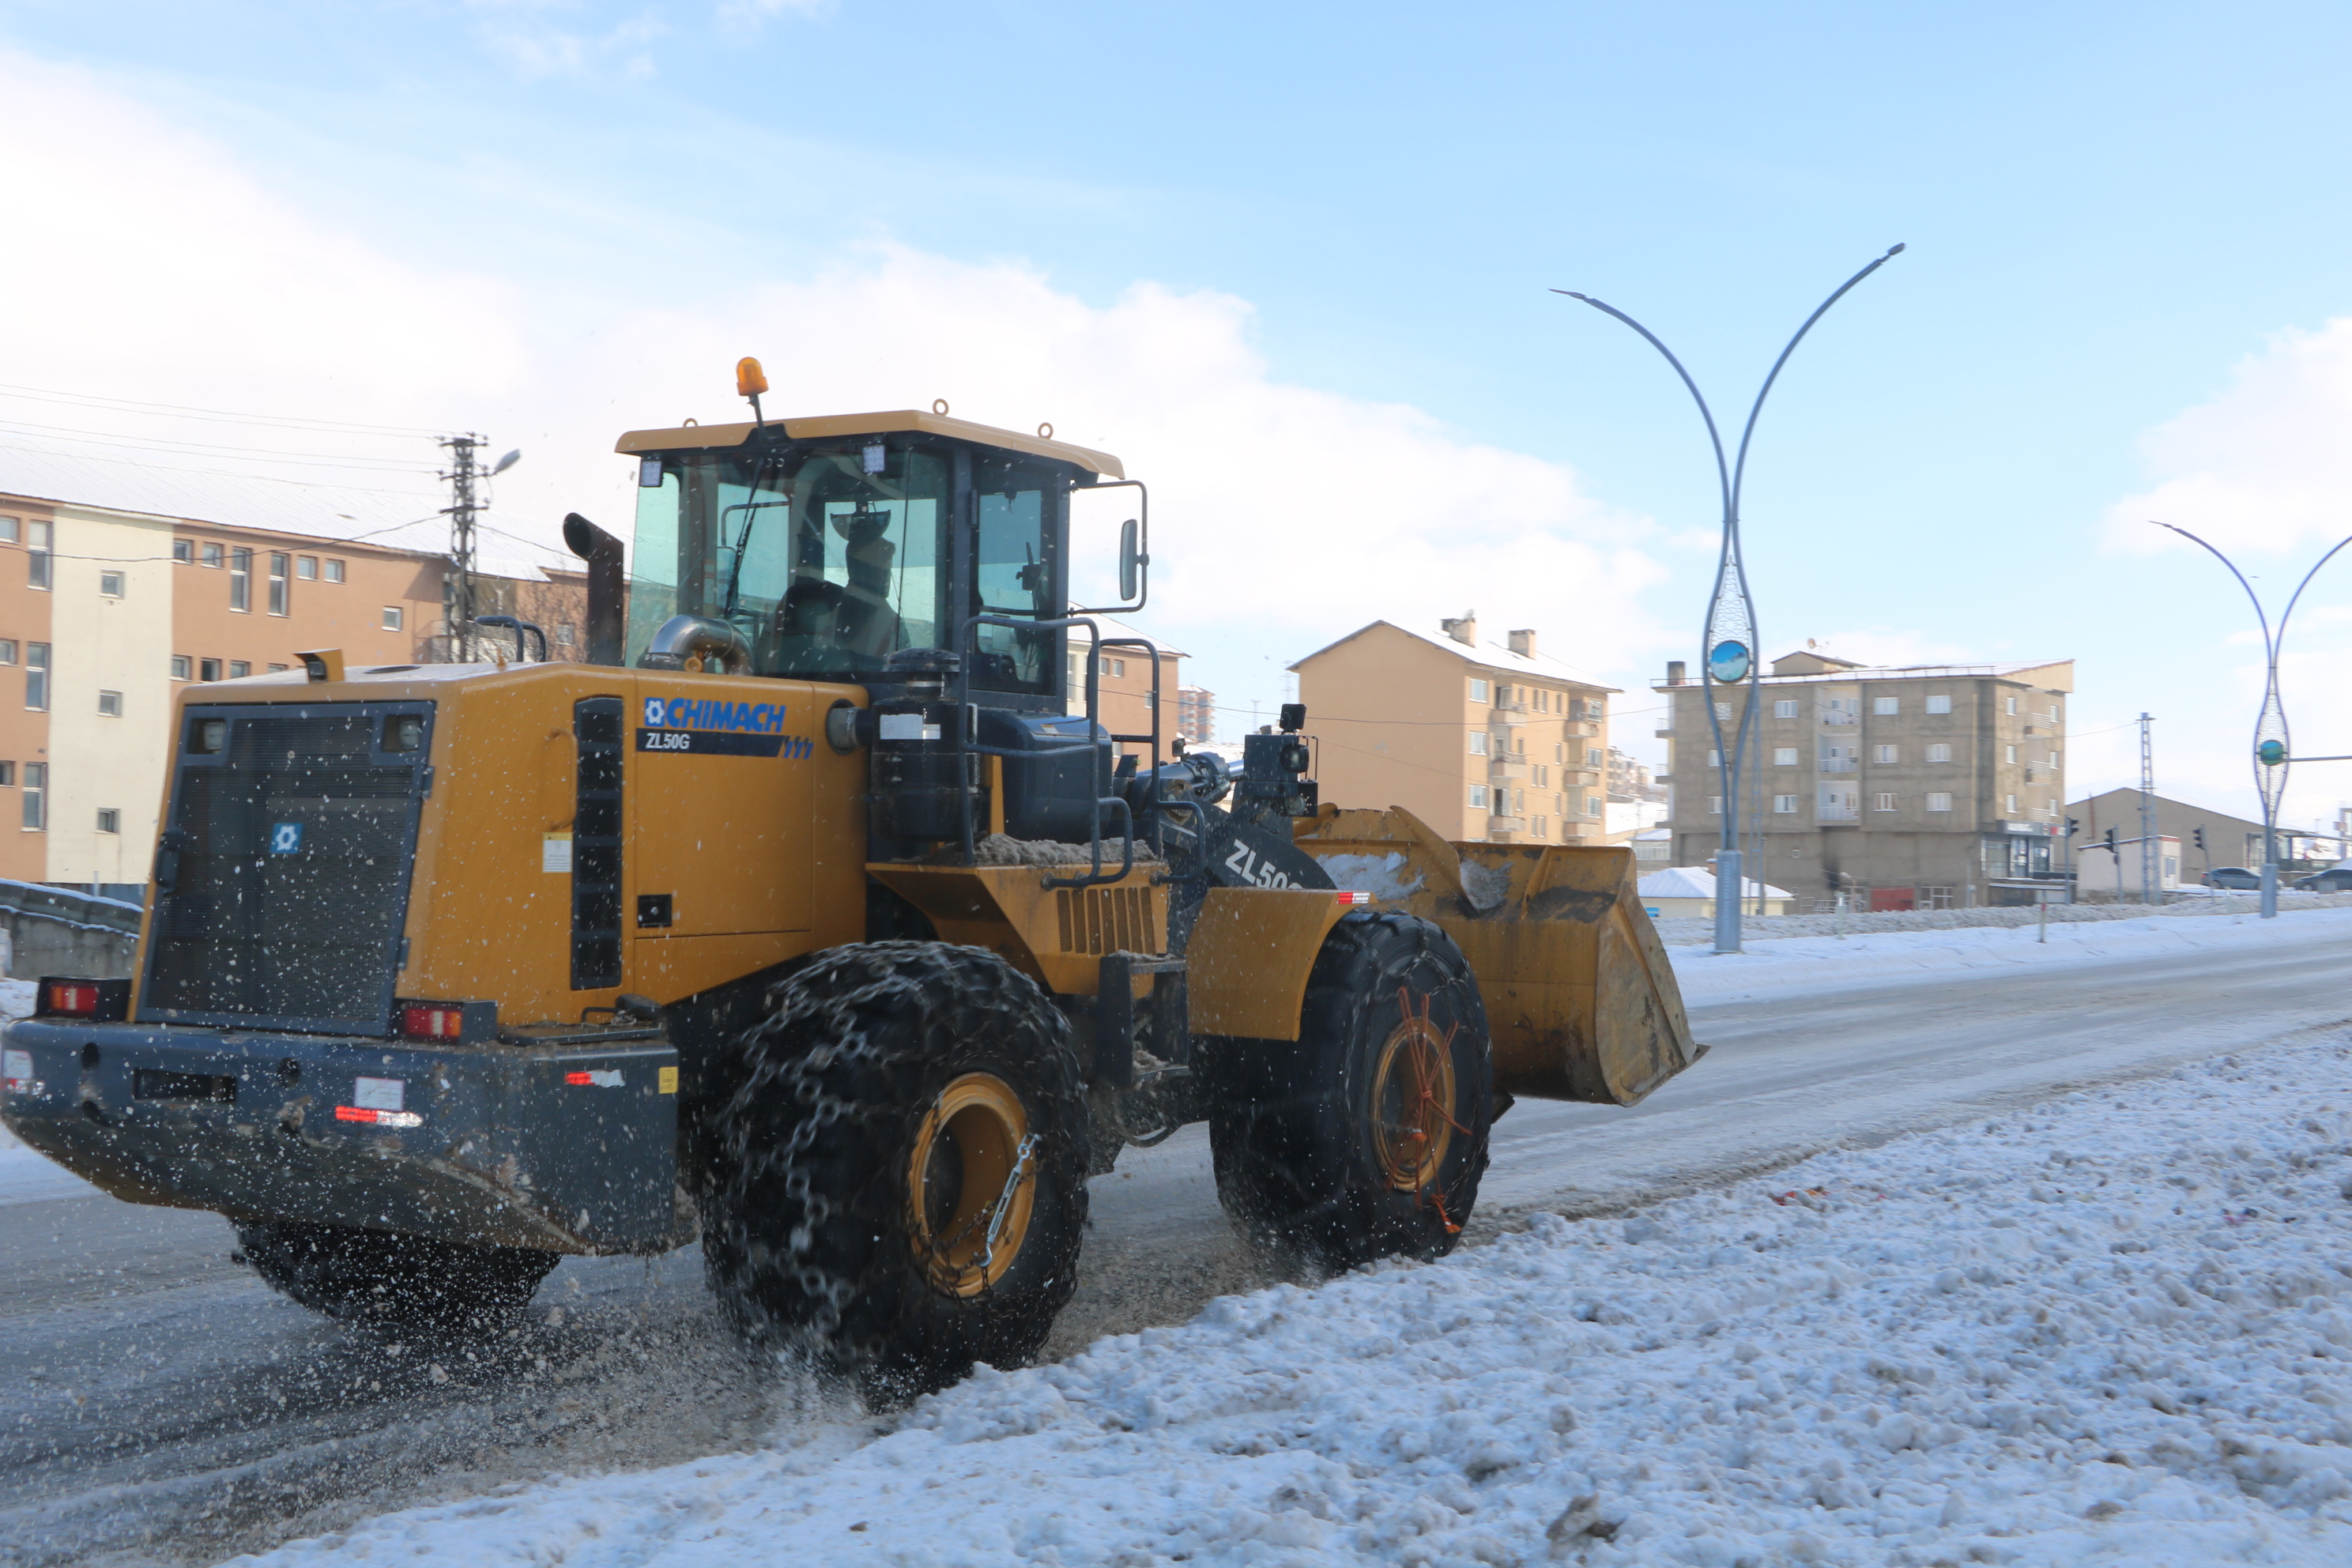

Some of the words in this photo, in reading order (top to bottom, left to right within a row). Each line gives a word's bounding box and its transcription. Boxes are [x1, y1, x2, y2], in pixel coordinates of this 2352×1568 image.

[666, 697, 786, 733] CHIMACH
[645, 733, 691, 750] ZL50G
[1225, 839, 1303, 889] ZL50
